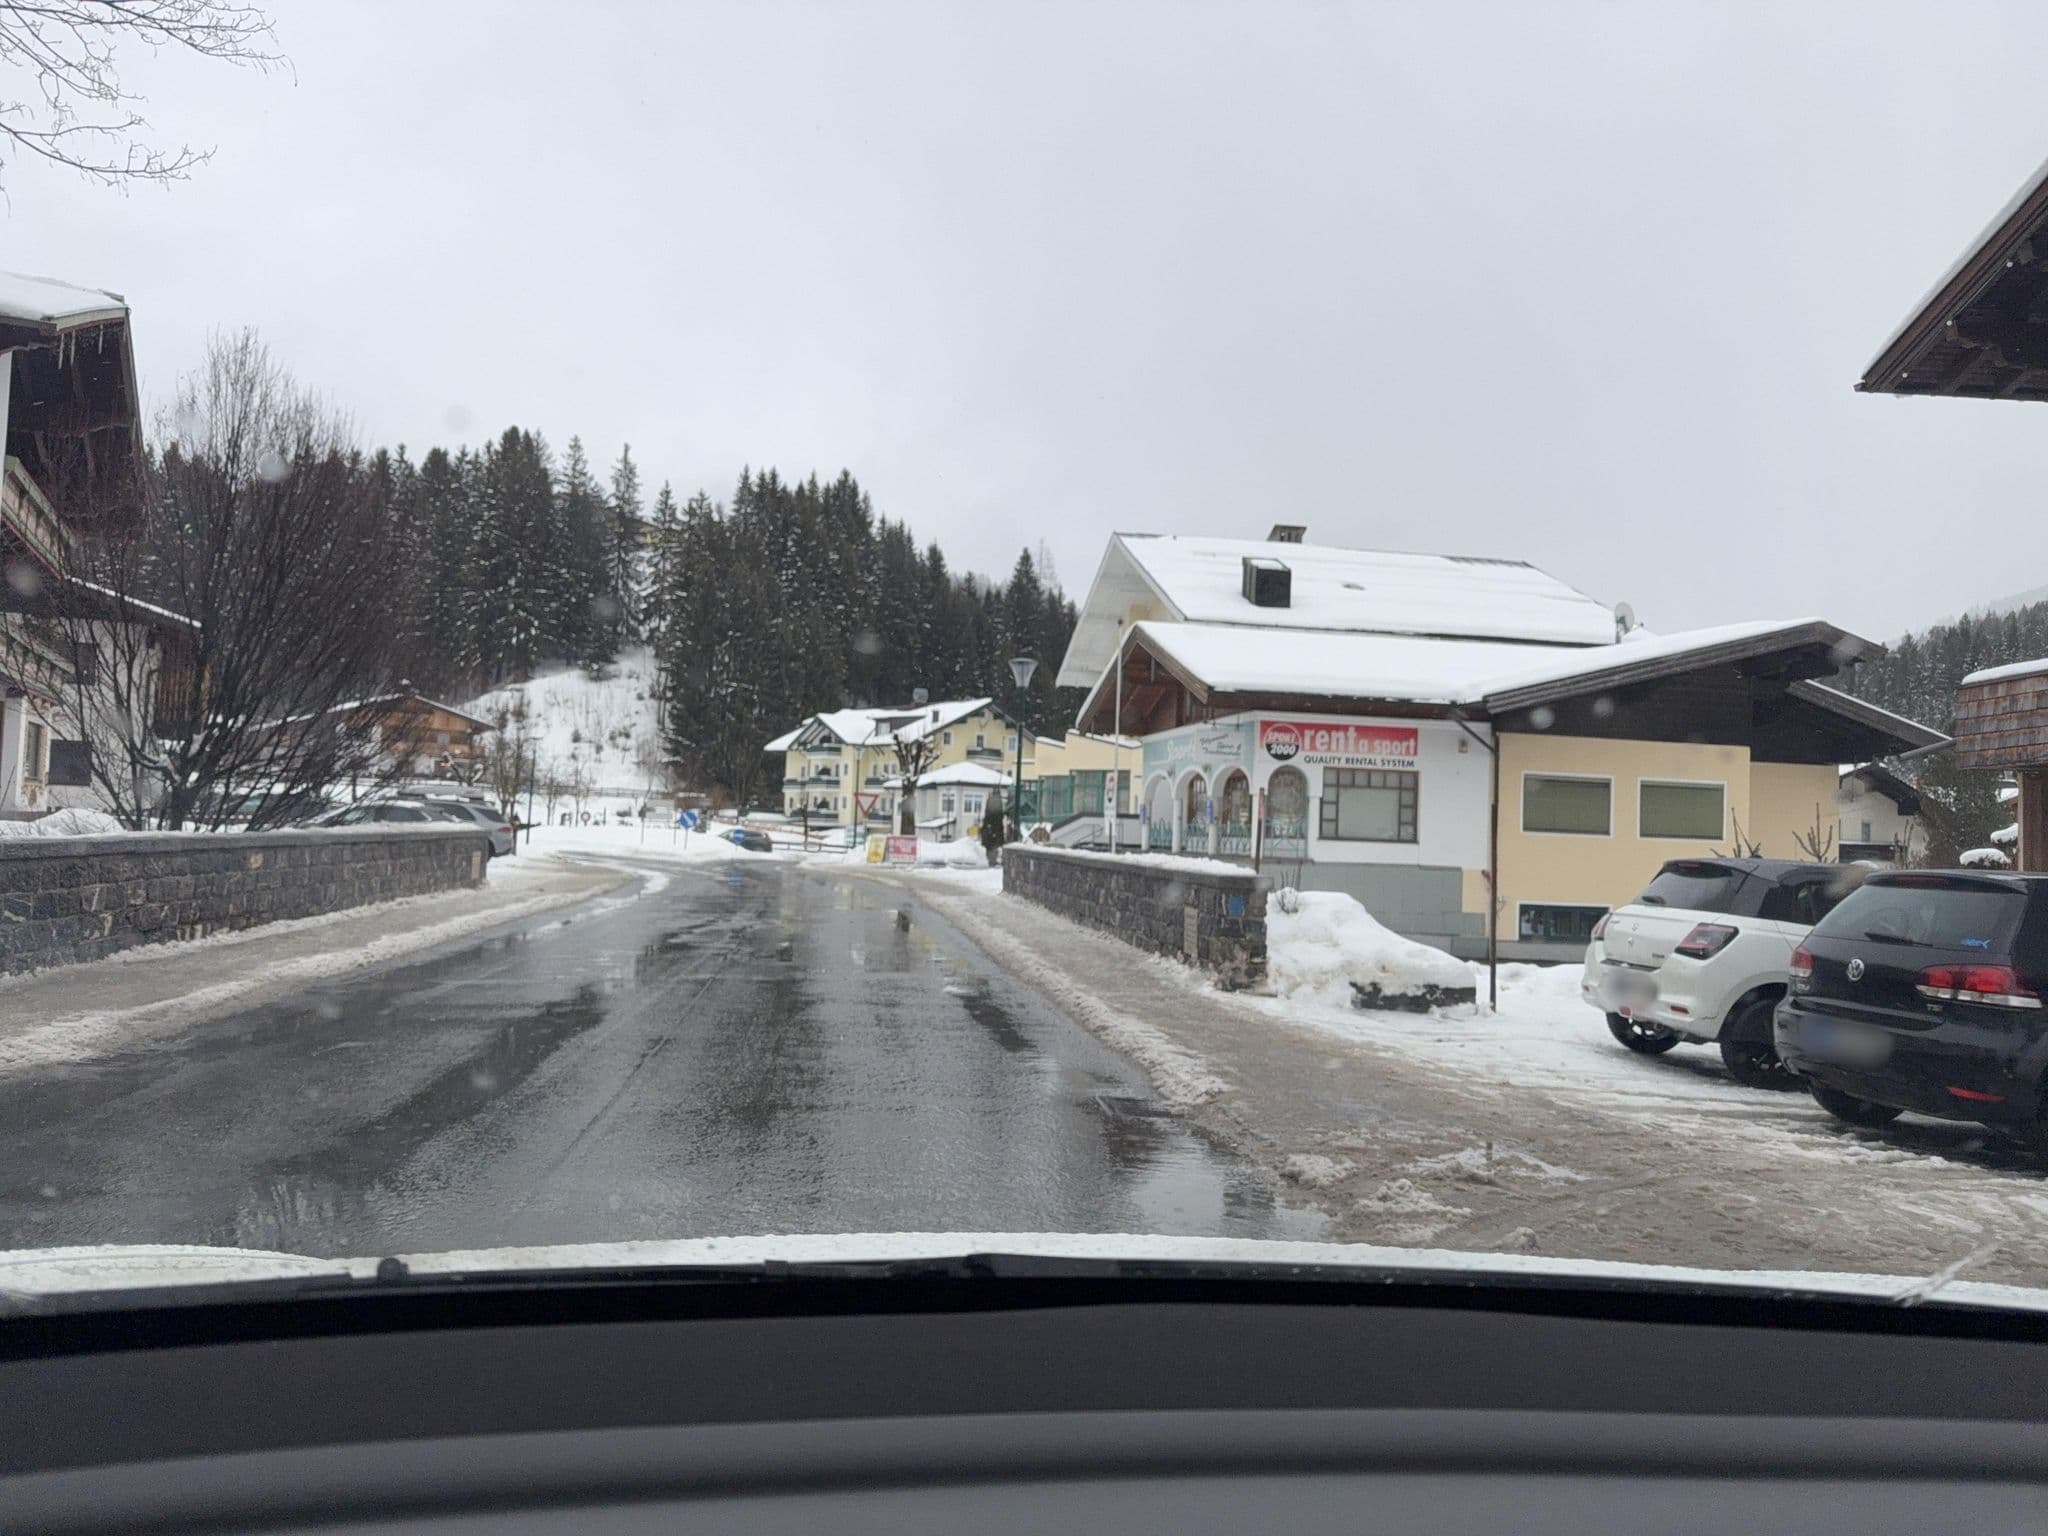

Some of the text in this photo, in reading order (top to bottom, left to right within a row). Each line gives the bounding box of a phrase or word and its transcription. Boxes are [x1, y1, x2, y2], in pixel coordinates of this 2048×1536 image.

[1268, 731, 1296, 743] SPORT
[1303, 727, 1416, 756] rent a sport
[1269, 744, 1297, 755] 2000
[1304, 755, 1415, 768] QUALITY RENTAL SYSTEM
